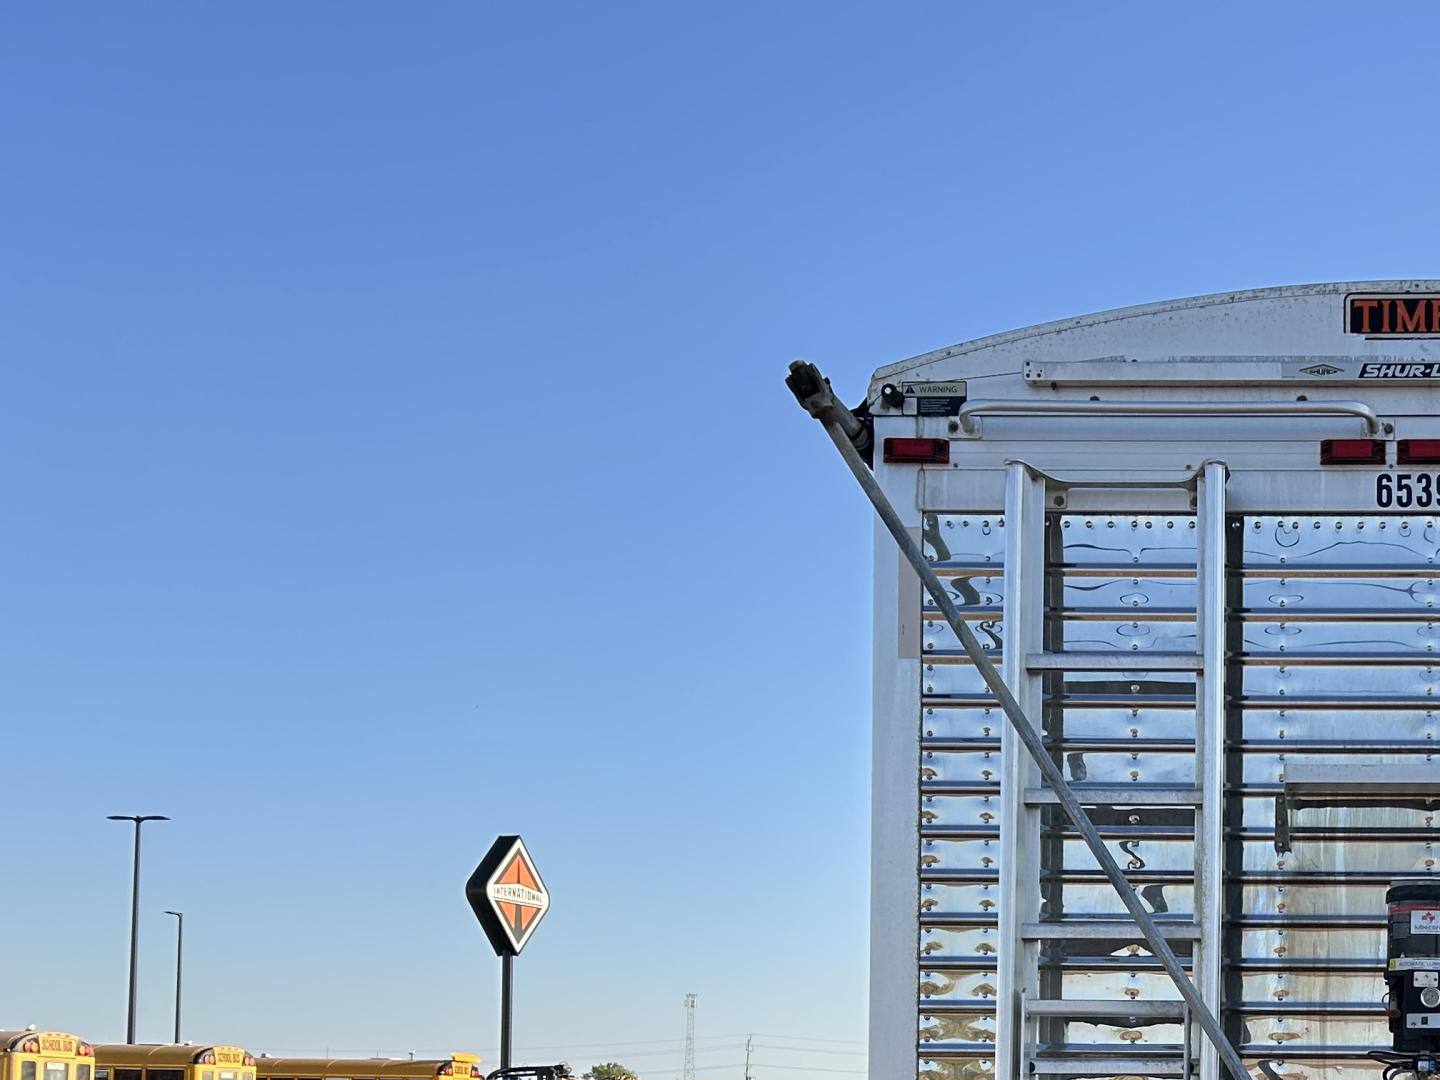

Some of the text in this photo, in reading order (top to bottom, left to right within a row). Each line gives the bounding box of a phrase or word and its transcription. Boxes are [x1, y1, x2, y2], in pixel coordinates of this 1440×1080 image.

[919, 385, 958, 394] WARNING
[493, 885, 543, 903] INTERNATIONAL
[41, 1038, 73, 1053] SCHOOL BUS
